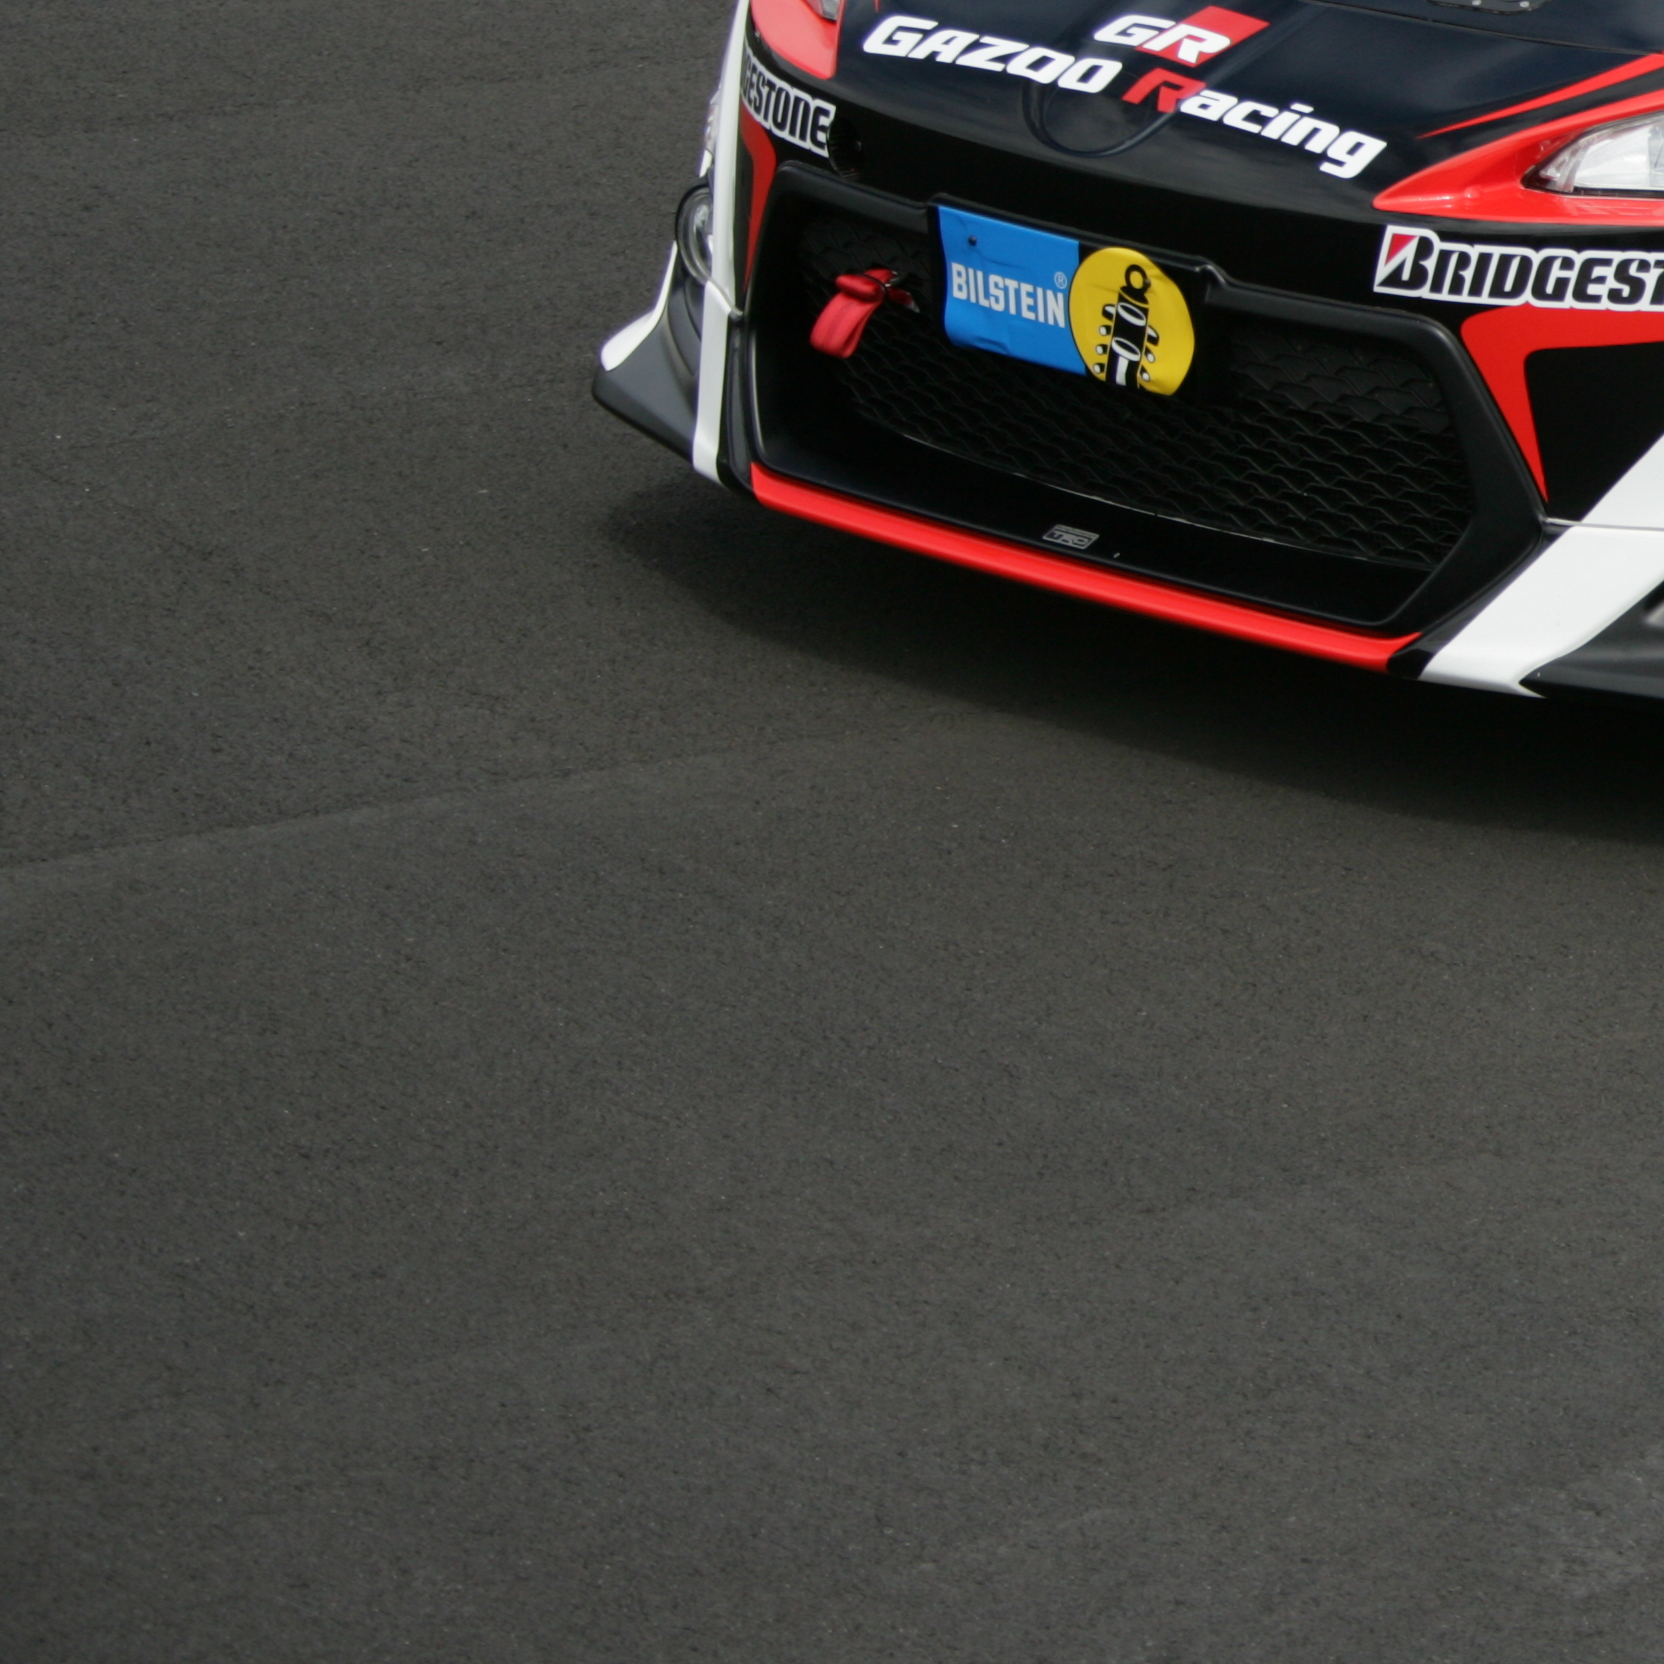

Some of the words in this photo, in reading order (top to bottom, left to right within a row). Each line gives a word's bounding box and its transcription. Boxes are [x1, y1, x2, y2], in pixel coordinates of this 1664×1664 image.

[1092, 14, 1232, 65] GR
[863, 14, 1123, 94] GAZOO
[1121, 66, 1388, 179] Racing
[951, 261, 1067, 329] BILSTEIN
